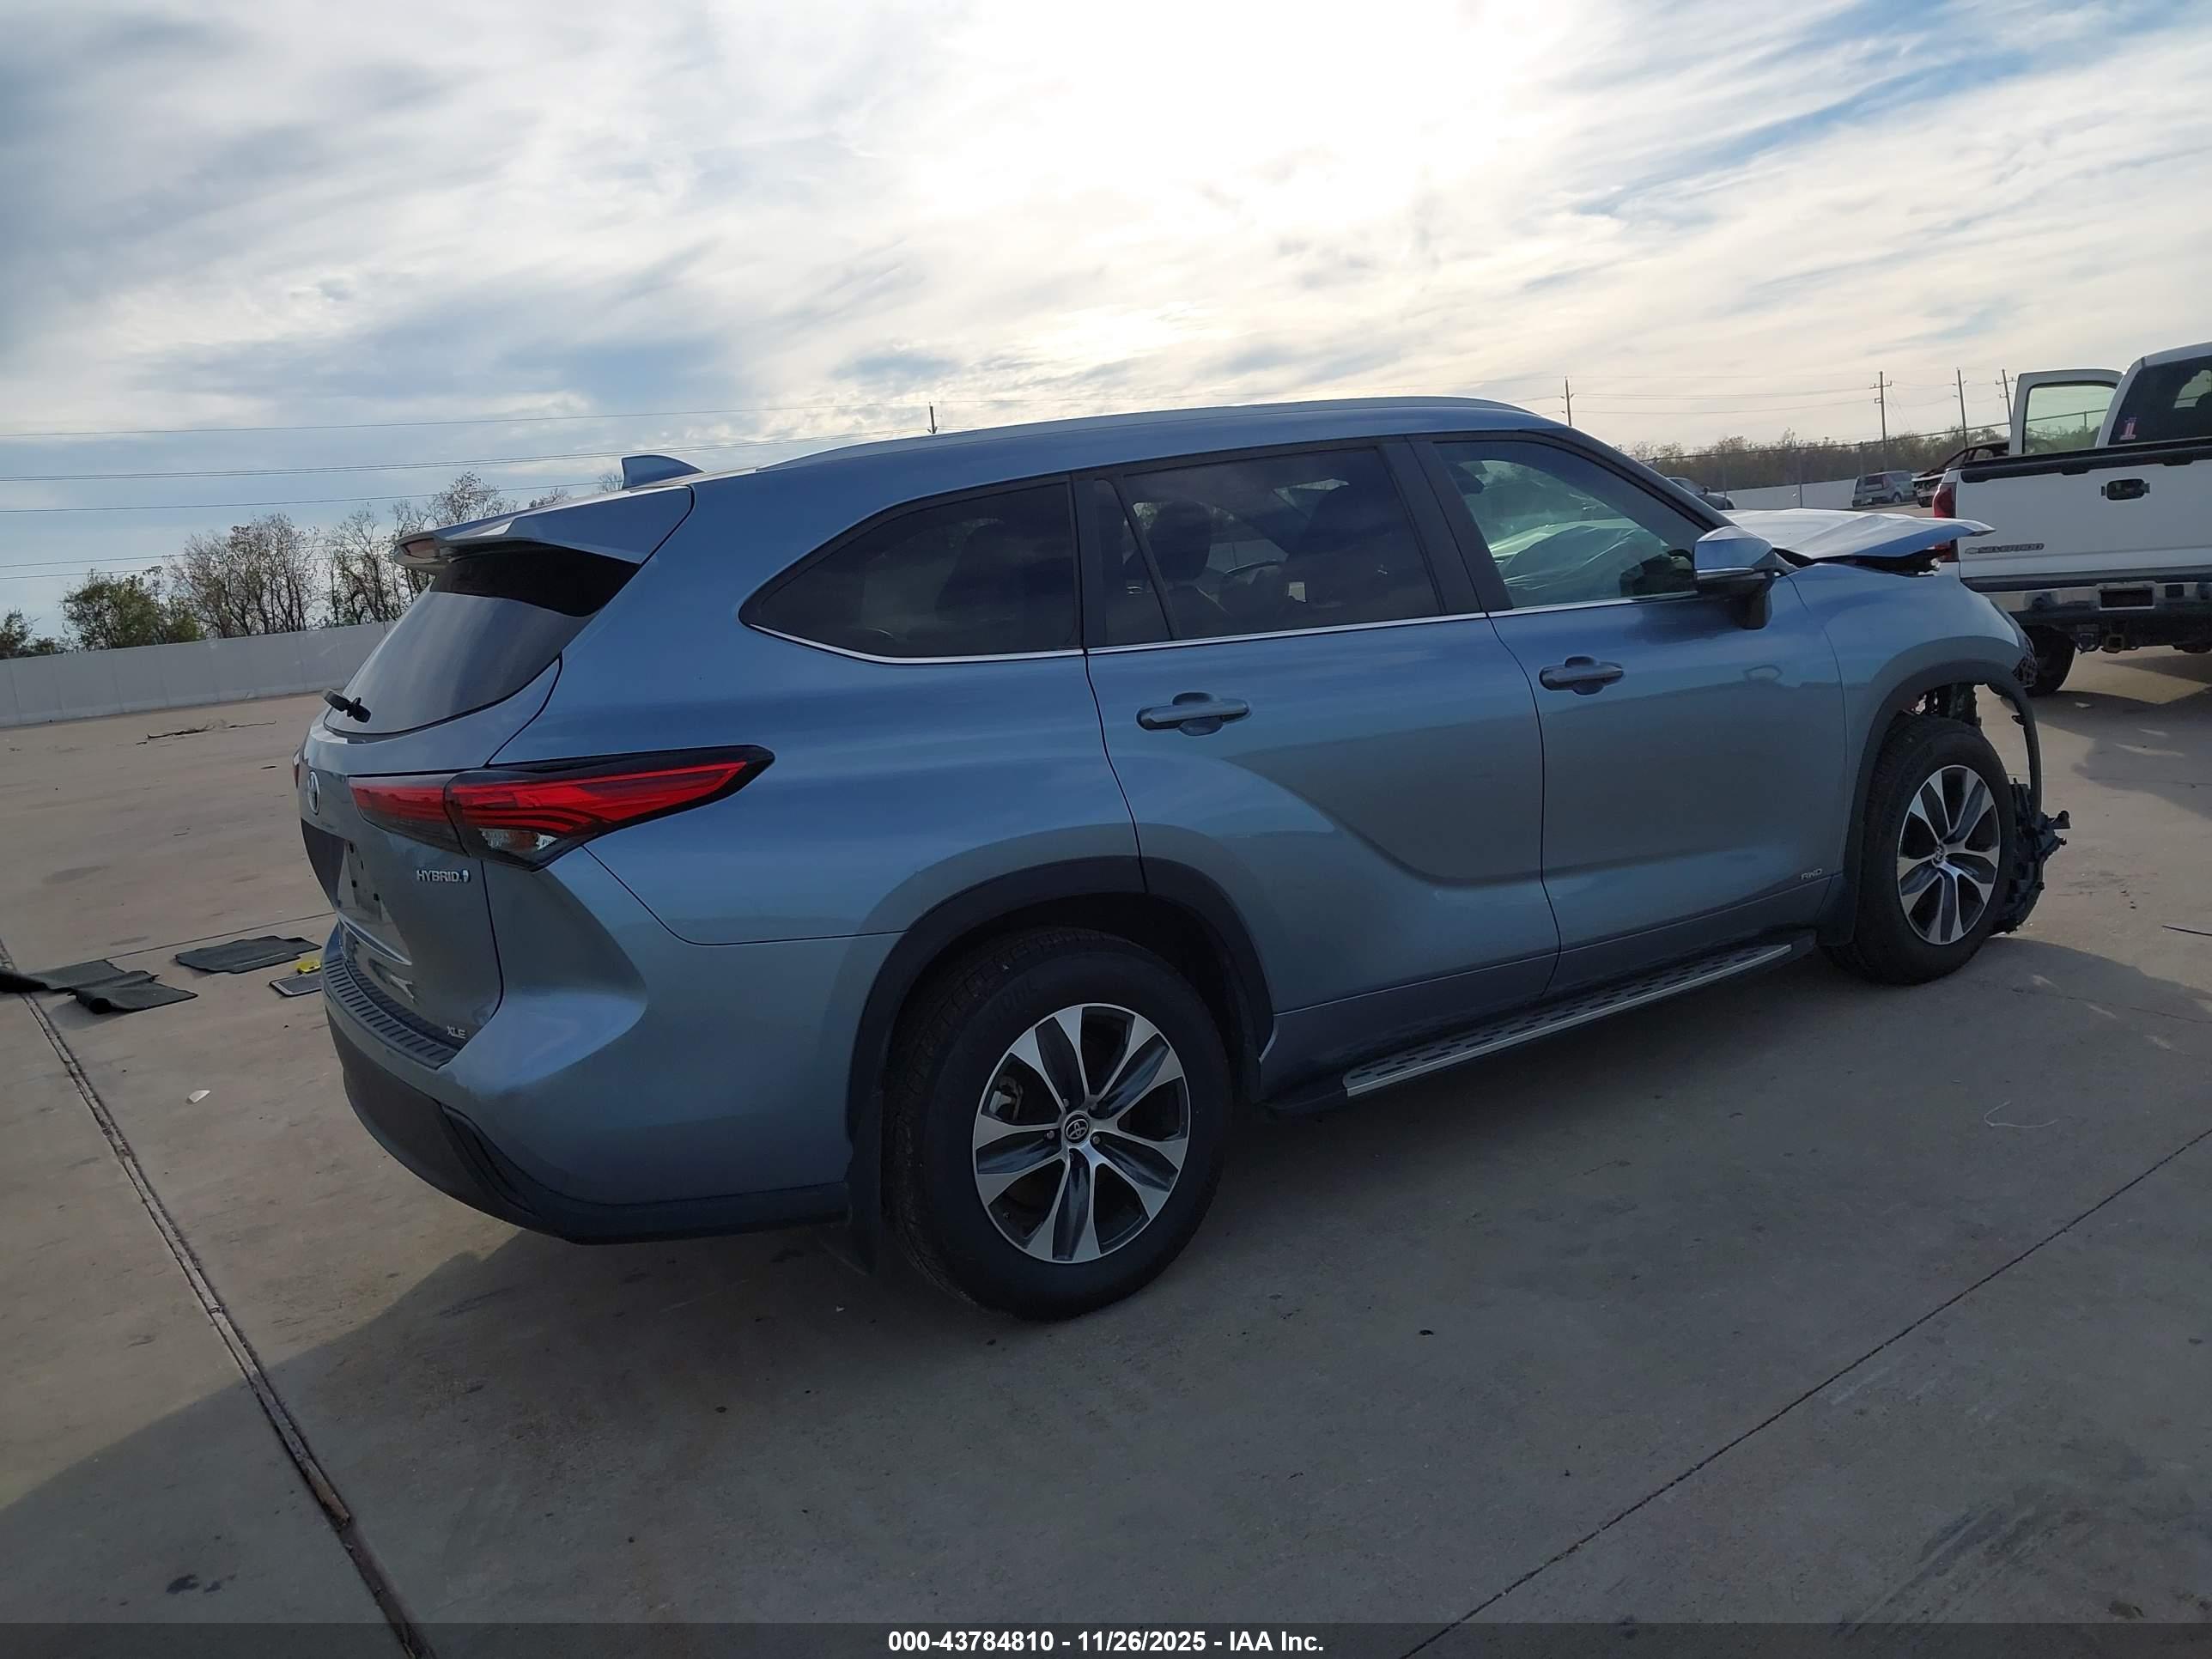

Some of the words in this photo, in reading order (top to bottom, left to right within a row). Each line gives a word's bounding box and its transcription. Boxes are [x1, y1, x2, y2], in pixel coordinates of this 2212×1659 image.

[1978, 543, 2045, 554] SILVERADO
[416, 870, 459, 882] HYBRID
[447, 1025, 466, 1039] XLE
